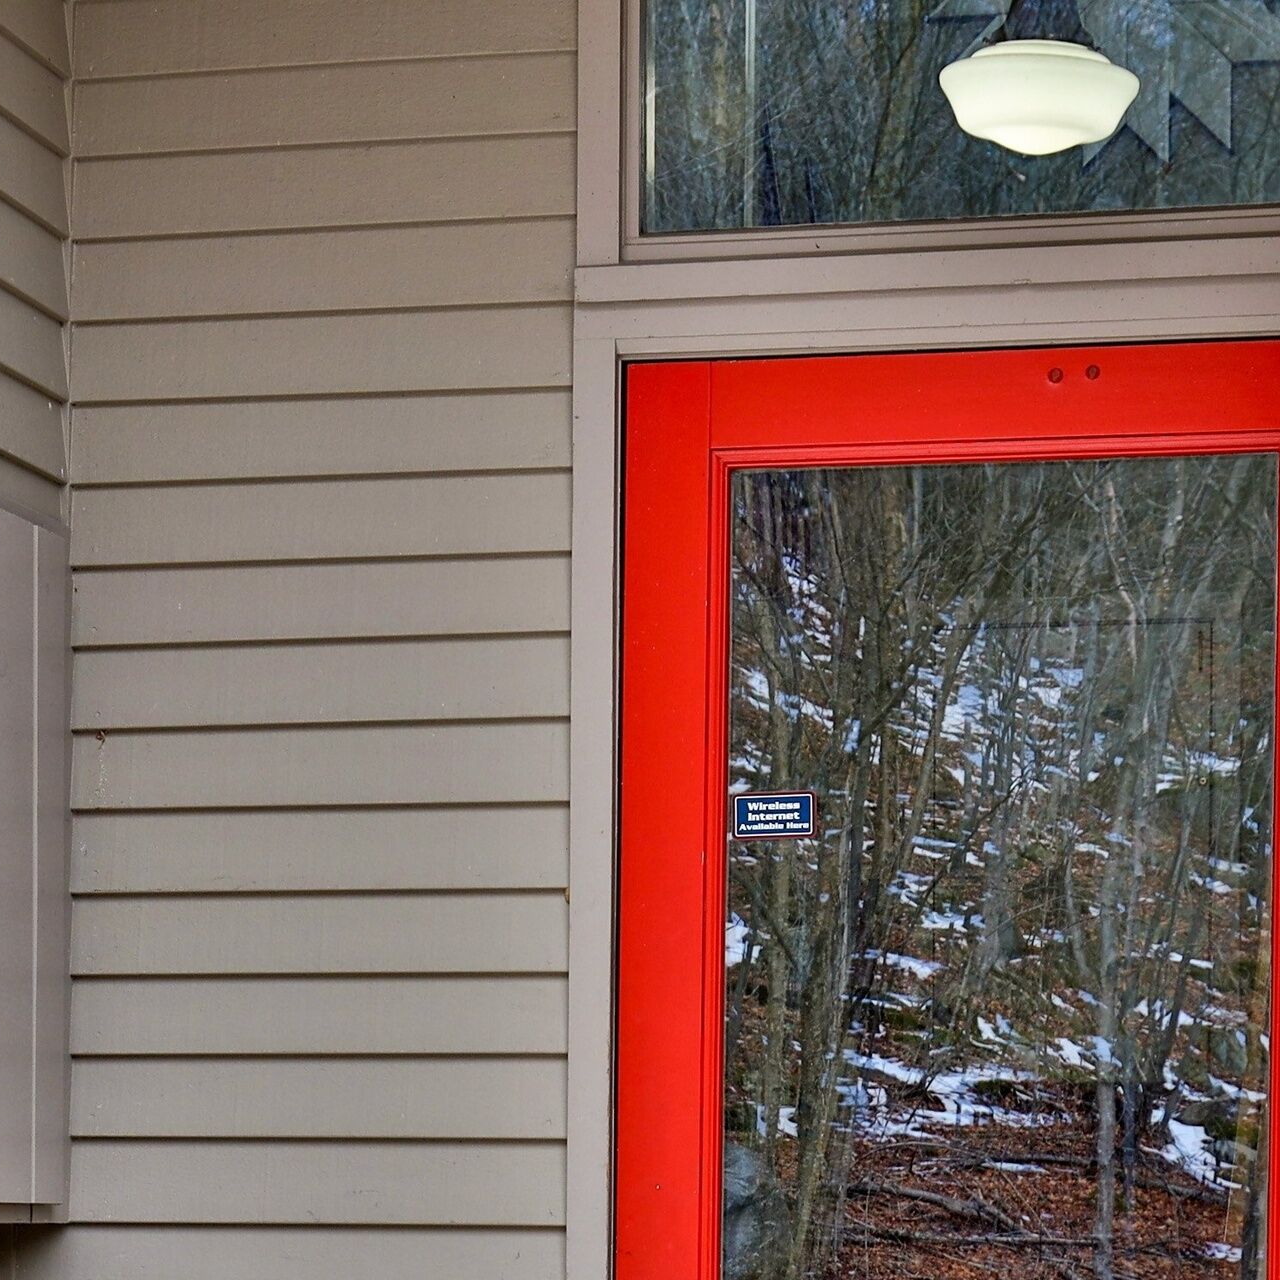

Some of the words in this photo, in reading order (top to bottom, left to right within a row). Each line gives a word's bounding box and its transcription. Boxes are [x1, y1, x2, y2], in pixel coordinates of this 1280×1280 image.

[748, 802, 800, 810] Wireless
[748, 812, 800, 822] Internet
[739, 823, 784, 831] Available
[786, 822, 809, 830] Here
